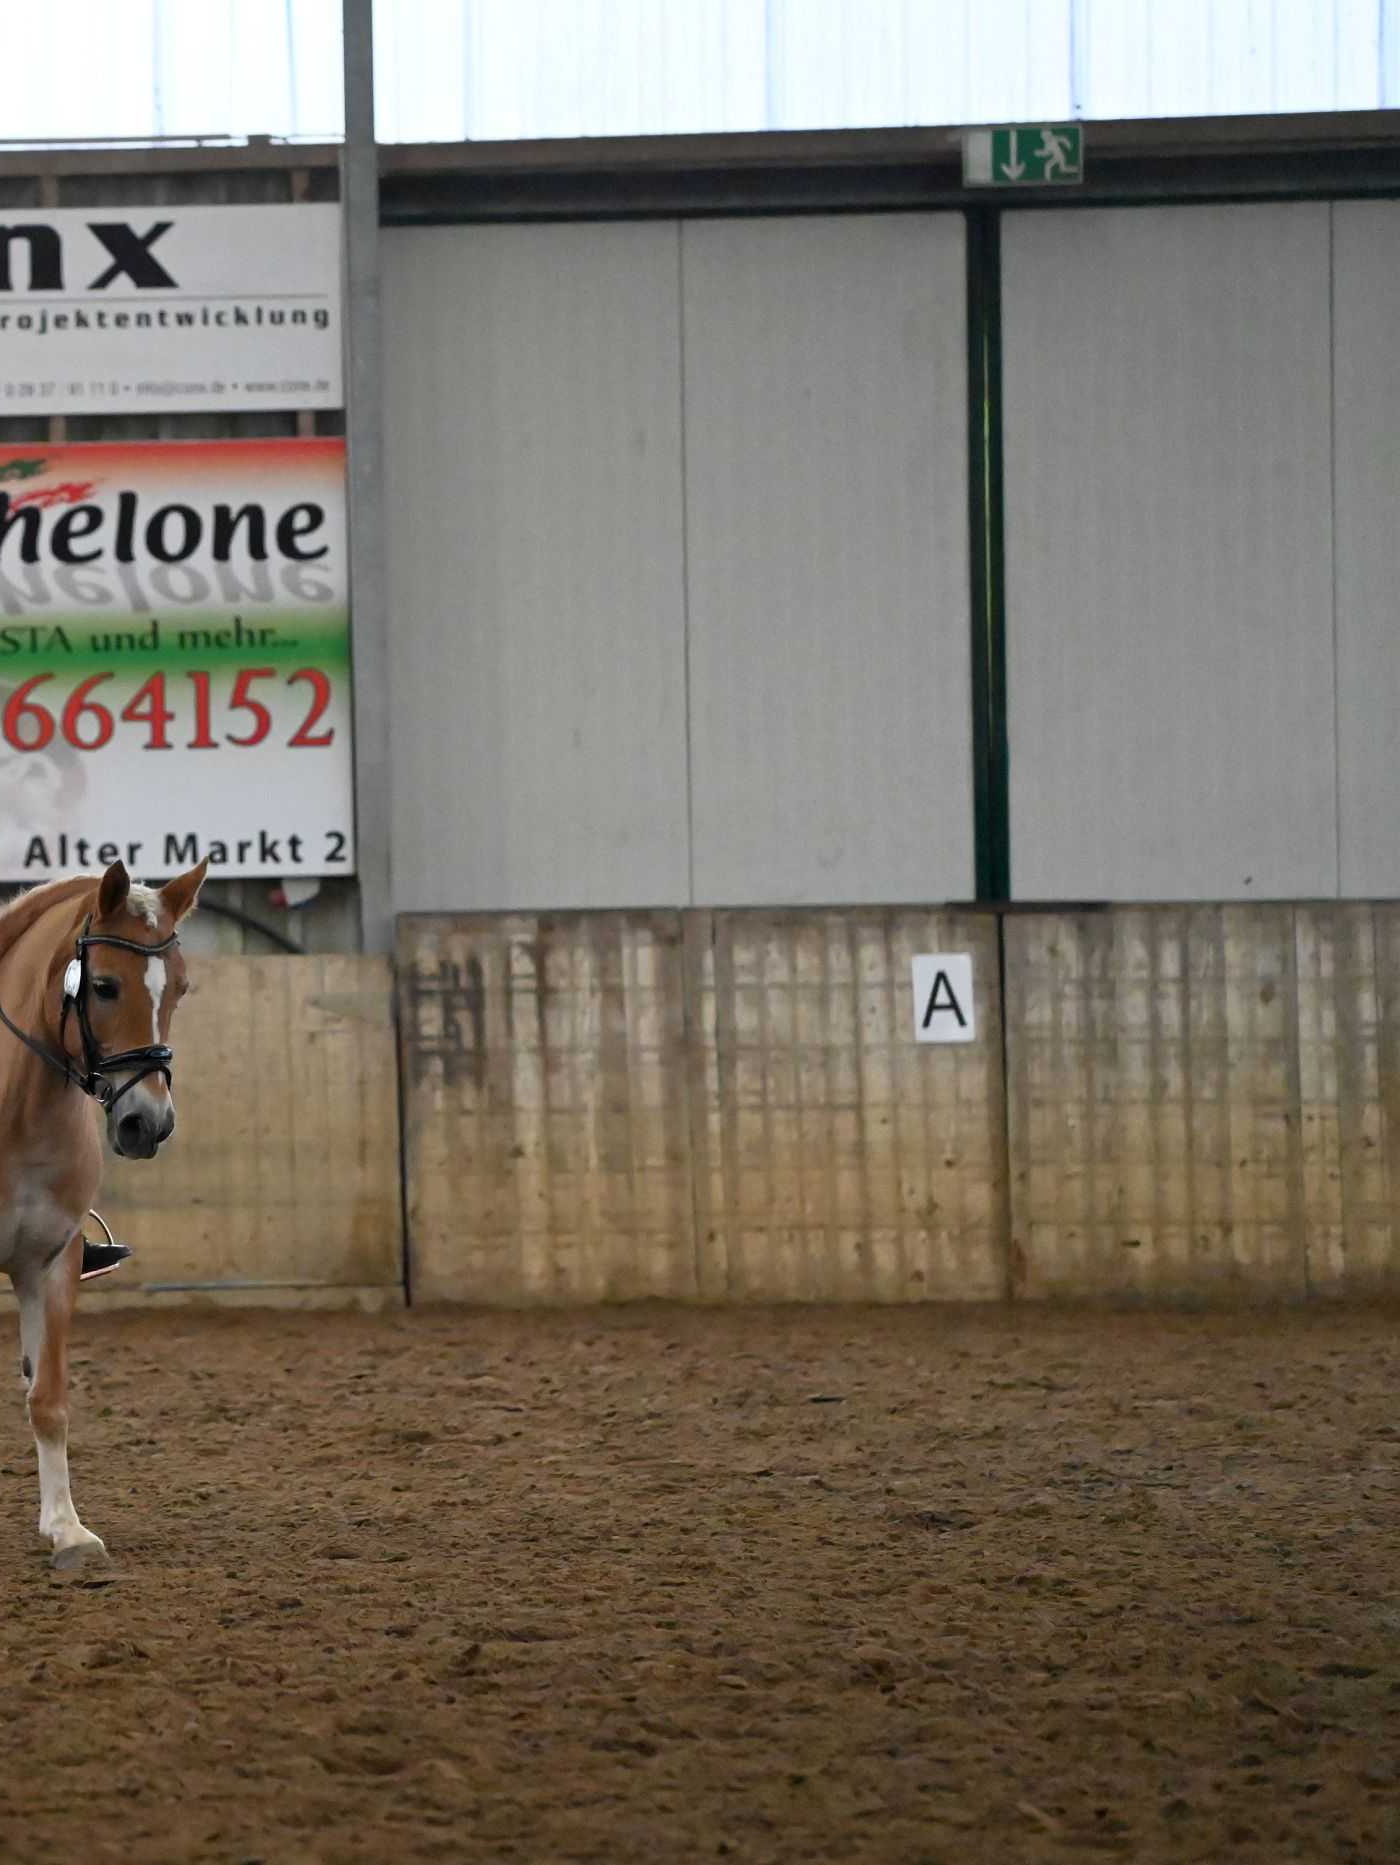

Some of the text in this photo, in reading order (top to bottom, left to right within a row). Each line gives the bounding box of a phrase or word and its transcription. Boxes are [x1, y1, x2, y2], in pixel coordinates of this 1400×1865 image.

[91, 620, 160, 652] und
[2, 667, 337, 753] 664152
[24, 830, 349, 869] Alter Markt 2
[922, 970, 968, 1030] A
